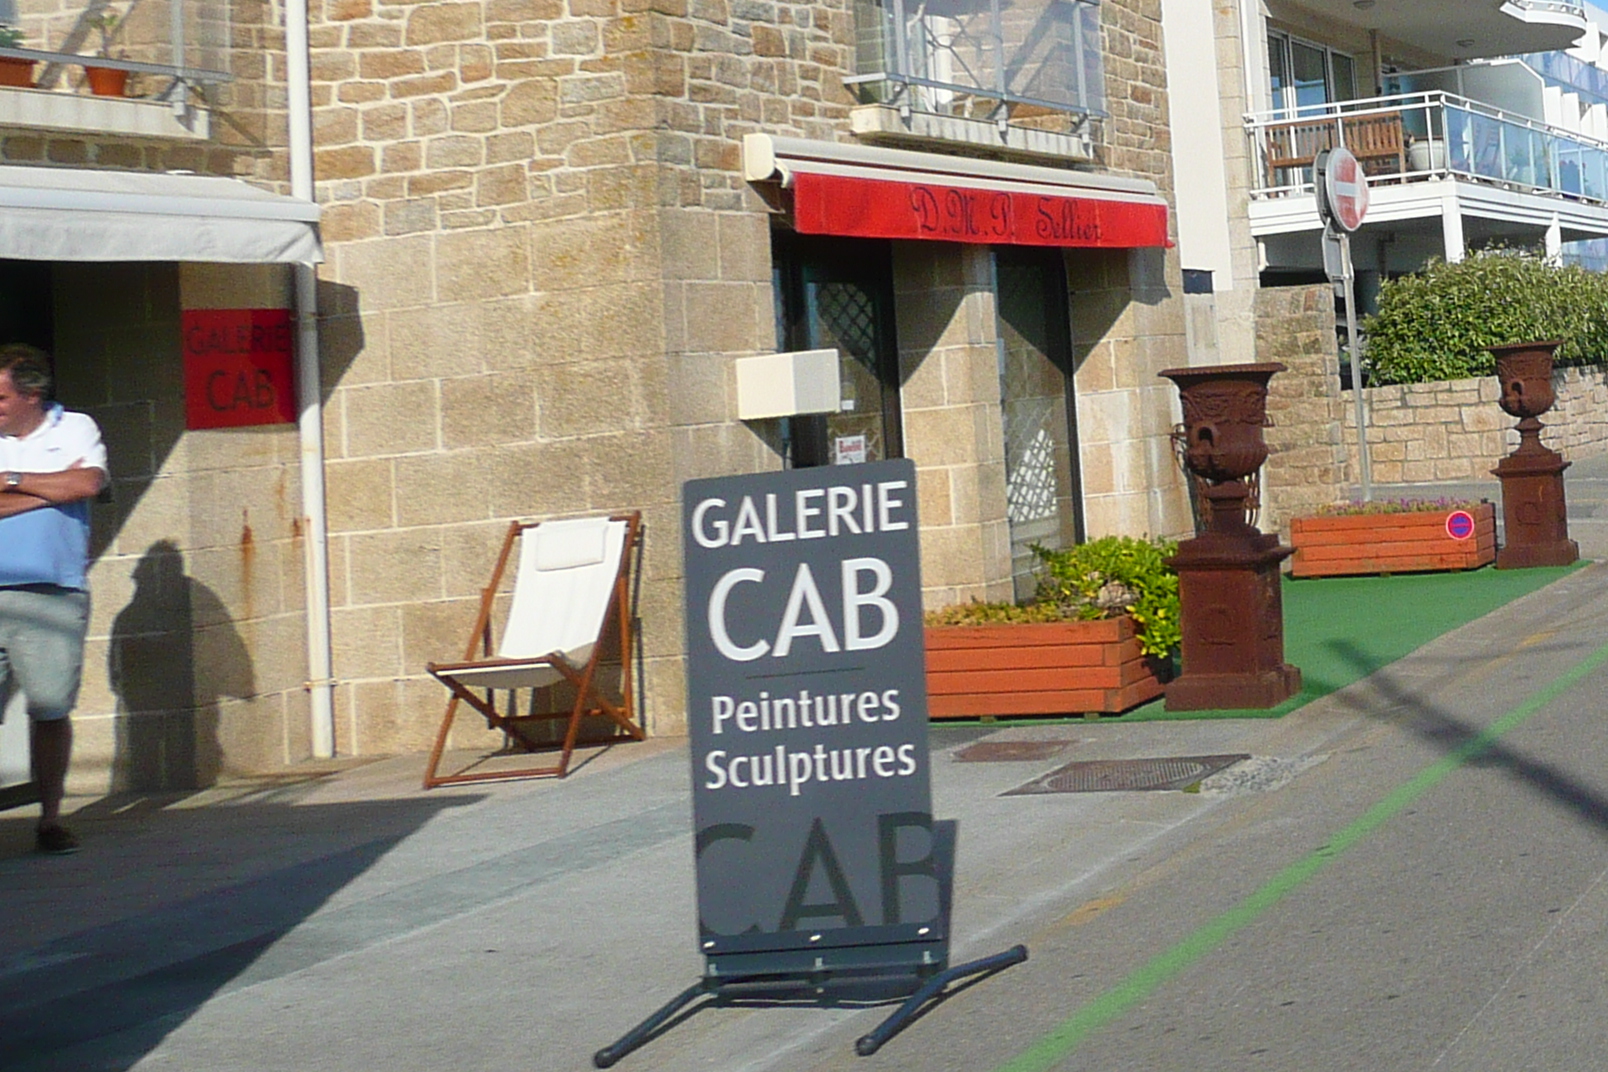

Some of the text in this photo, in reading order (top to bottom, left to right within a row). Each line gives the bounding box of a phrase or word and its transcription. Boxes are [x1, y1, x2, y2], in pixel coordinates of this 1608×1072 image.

[187, 325, 289, 355] GALERIE
[206, 369, 275, 412] CAB
[691, 480, 909, 549] GALERIE
[707, 556, 900, 662] CAB
[711, 689, 902, 735] Peintures
[704, 743, 917, 797] Sculptures
